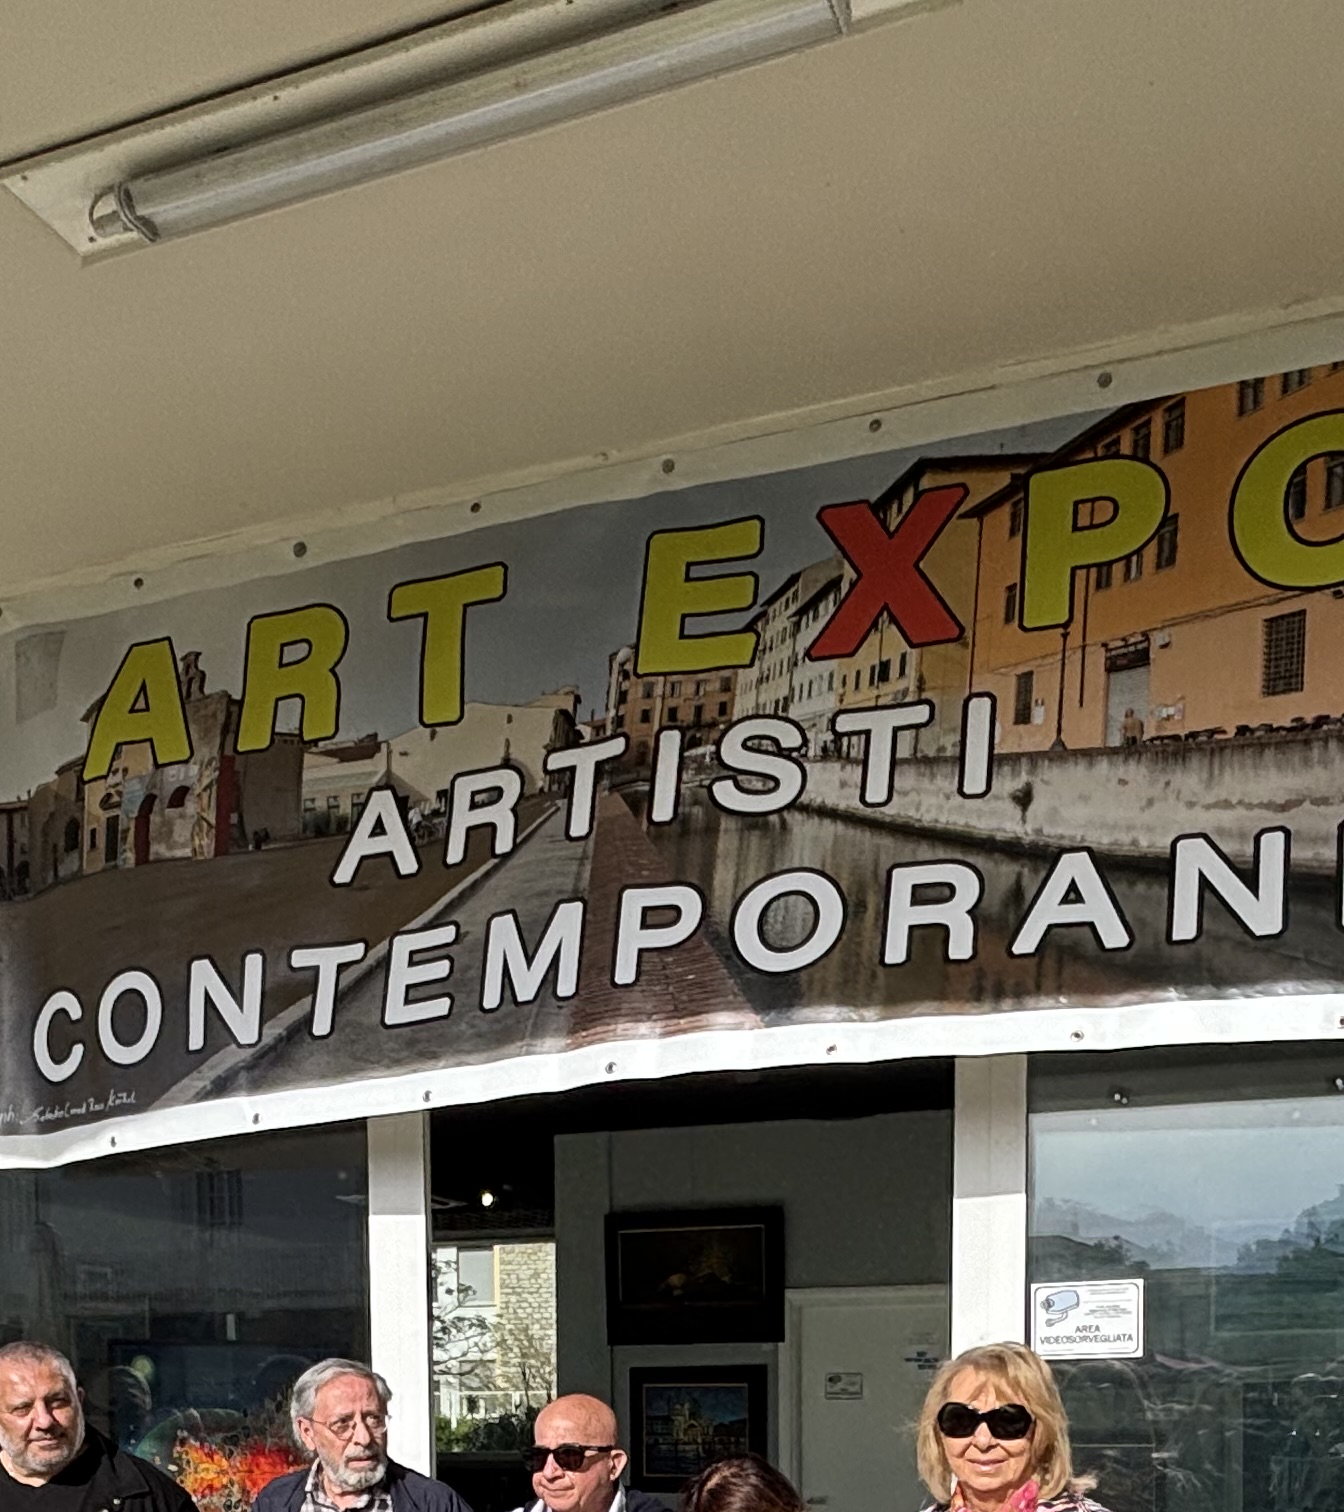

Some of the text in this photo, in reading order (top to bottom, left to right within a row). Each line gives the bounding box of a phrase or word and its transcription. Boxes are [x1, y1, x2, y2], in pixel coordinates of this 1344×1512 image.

[82, 562, 508, 783] ART
[329, 692, 998, 888] ARTISTI
[1040, 1333, 1133, 1345] VIDEOSORVEGLIATA
[1075, 1325, 1101, 1334] AREA
